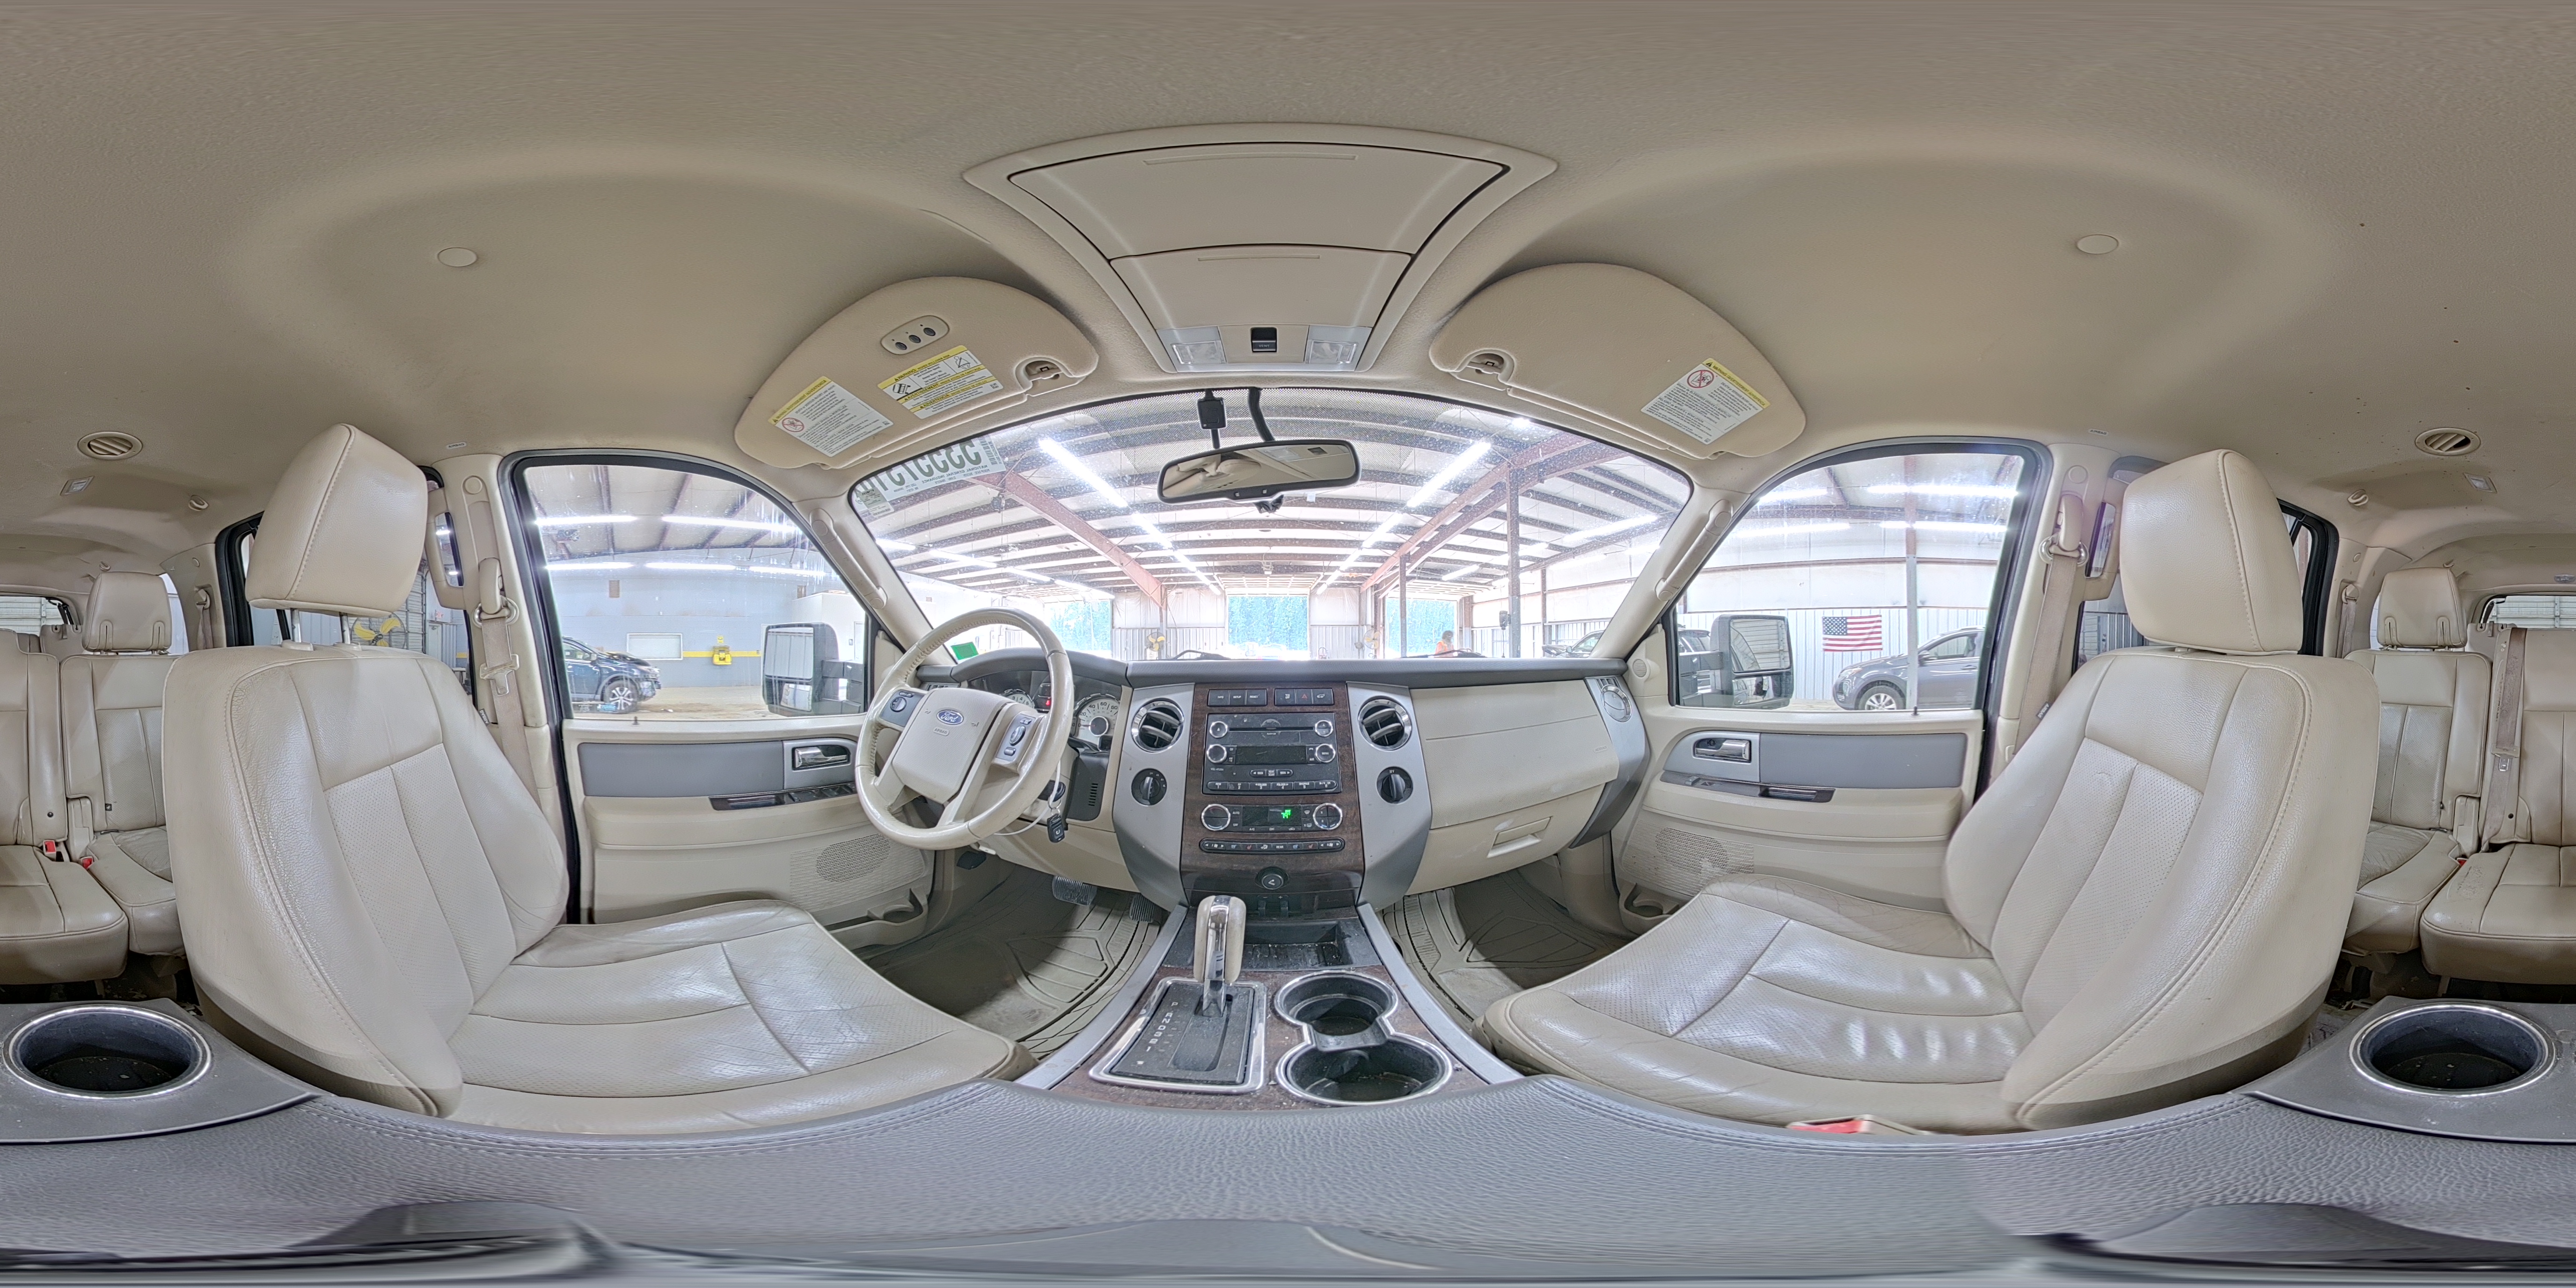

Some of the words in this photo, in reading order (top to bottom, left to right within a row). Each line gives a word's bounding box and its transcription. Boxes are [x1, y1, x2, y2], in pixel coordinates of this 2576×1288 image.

[480, 710, 489, 724] AIRBAG
[940, 711, 959, 722] Ford
[2037, 703, 2049, 718] AIRBAG
